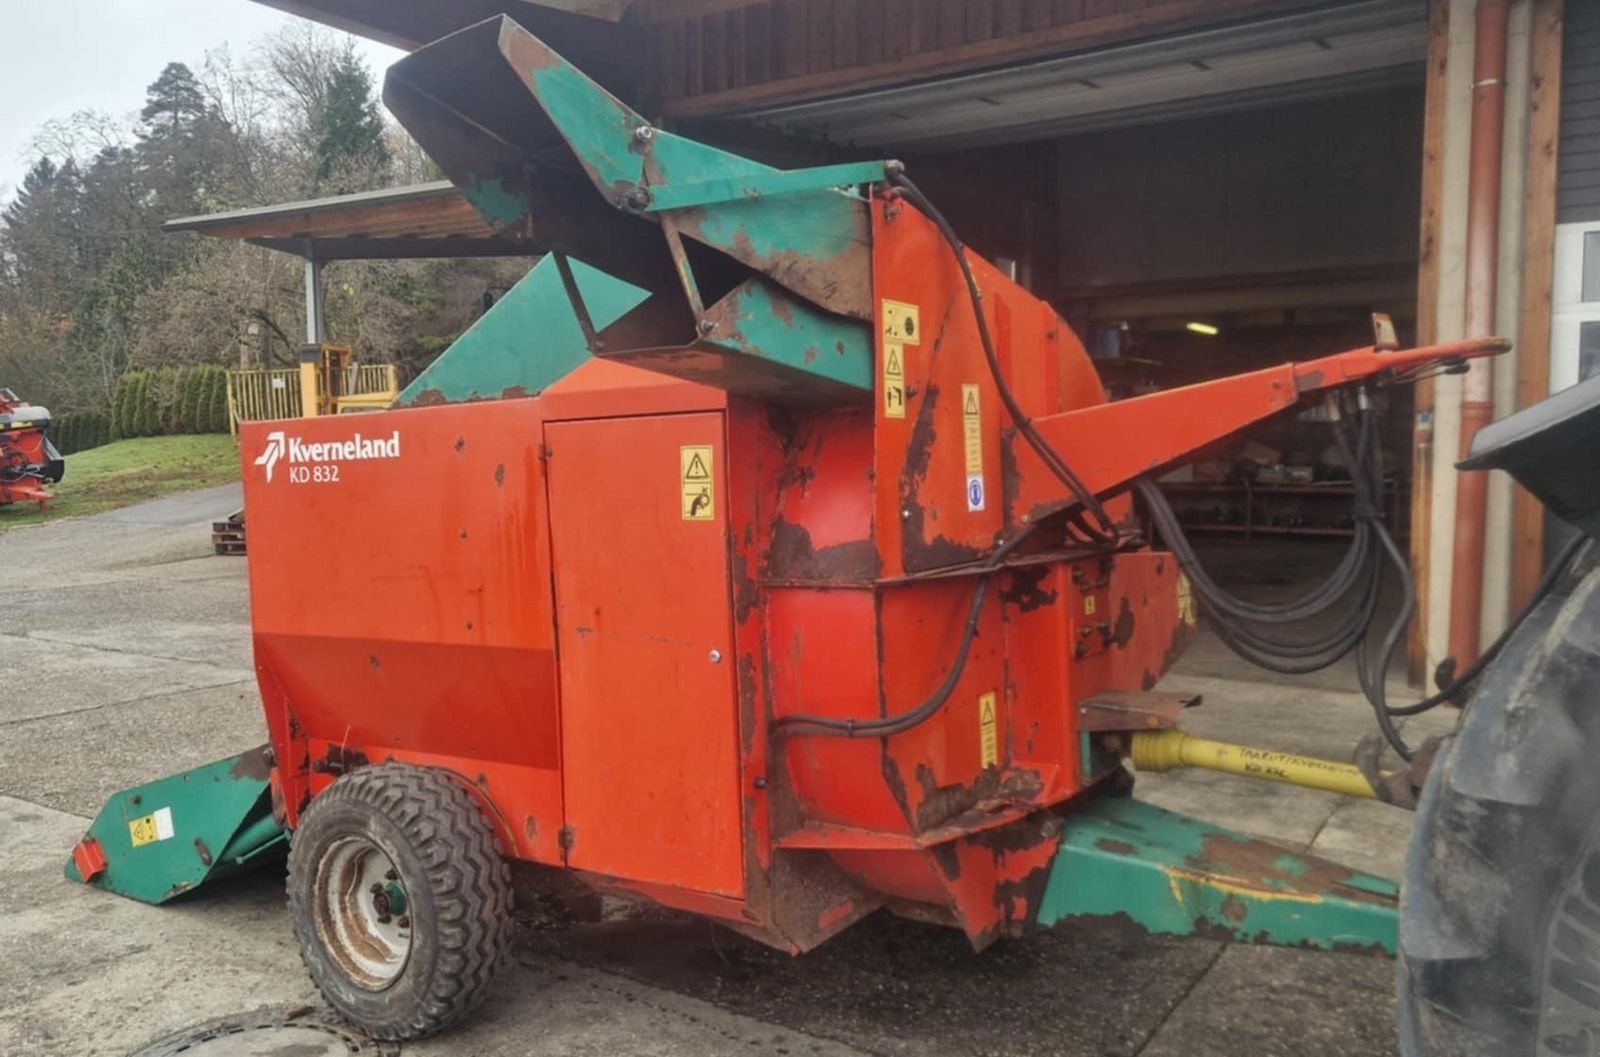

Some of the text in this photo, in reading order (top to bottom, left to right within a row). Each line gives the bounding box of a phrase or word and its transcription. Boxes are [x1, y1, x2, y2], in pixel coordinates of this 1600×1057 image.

[288, 431, 400, 463] Kverneland
[289, 465, 340, 484] KD 832
